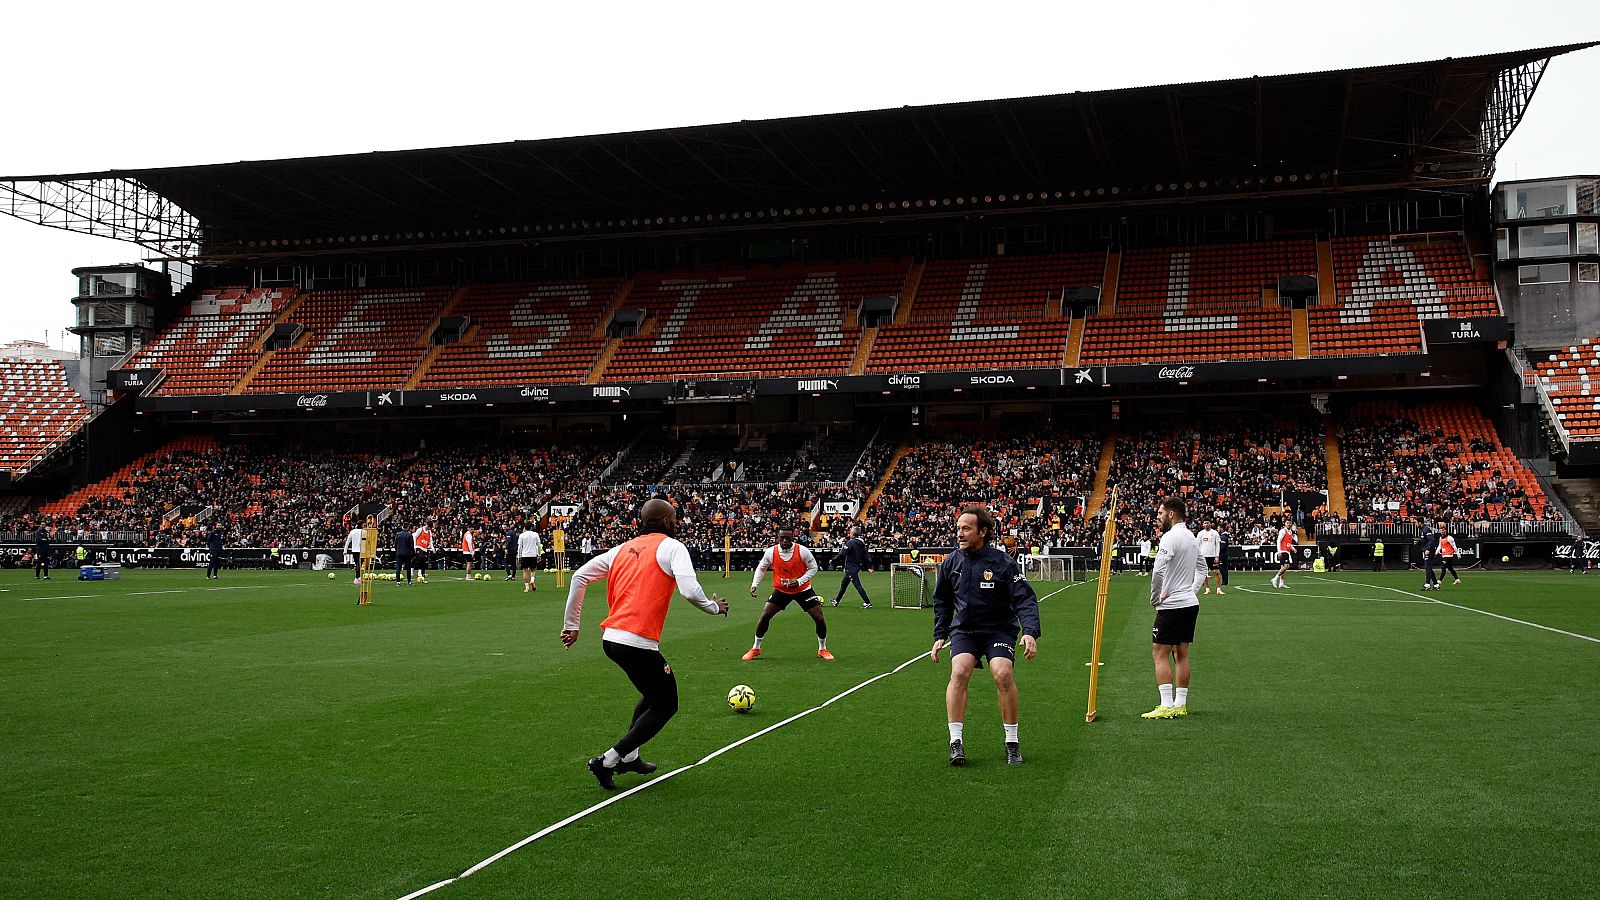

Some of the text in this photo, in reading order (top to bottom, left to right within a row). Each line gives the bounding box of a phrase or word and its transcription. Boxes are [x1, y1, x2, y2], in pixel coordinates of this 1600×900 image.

[888, 375, 920, 385] divina
[971, 376, 1014, 384] SKODA
[798, 380, 828, 390] PUMA
[521, 388, 549, 397] divina
[593, 387, 620, 397] PUMA
[440, 393, 477, 401] SKODA
